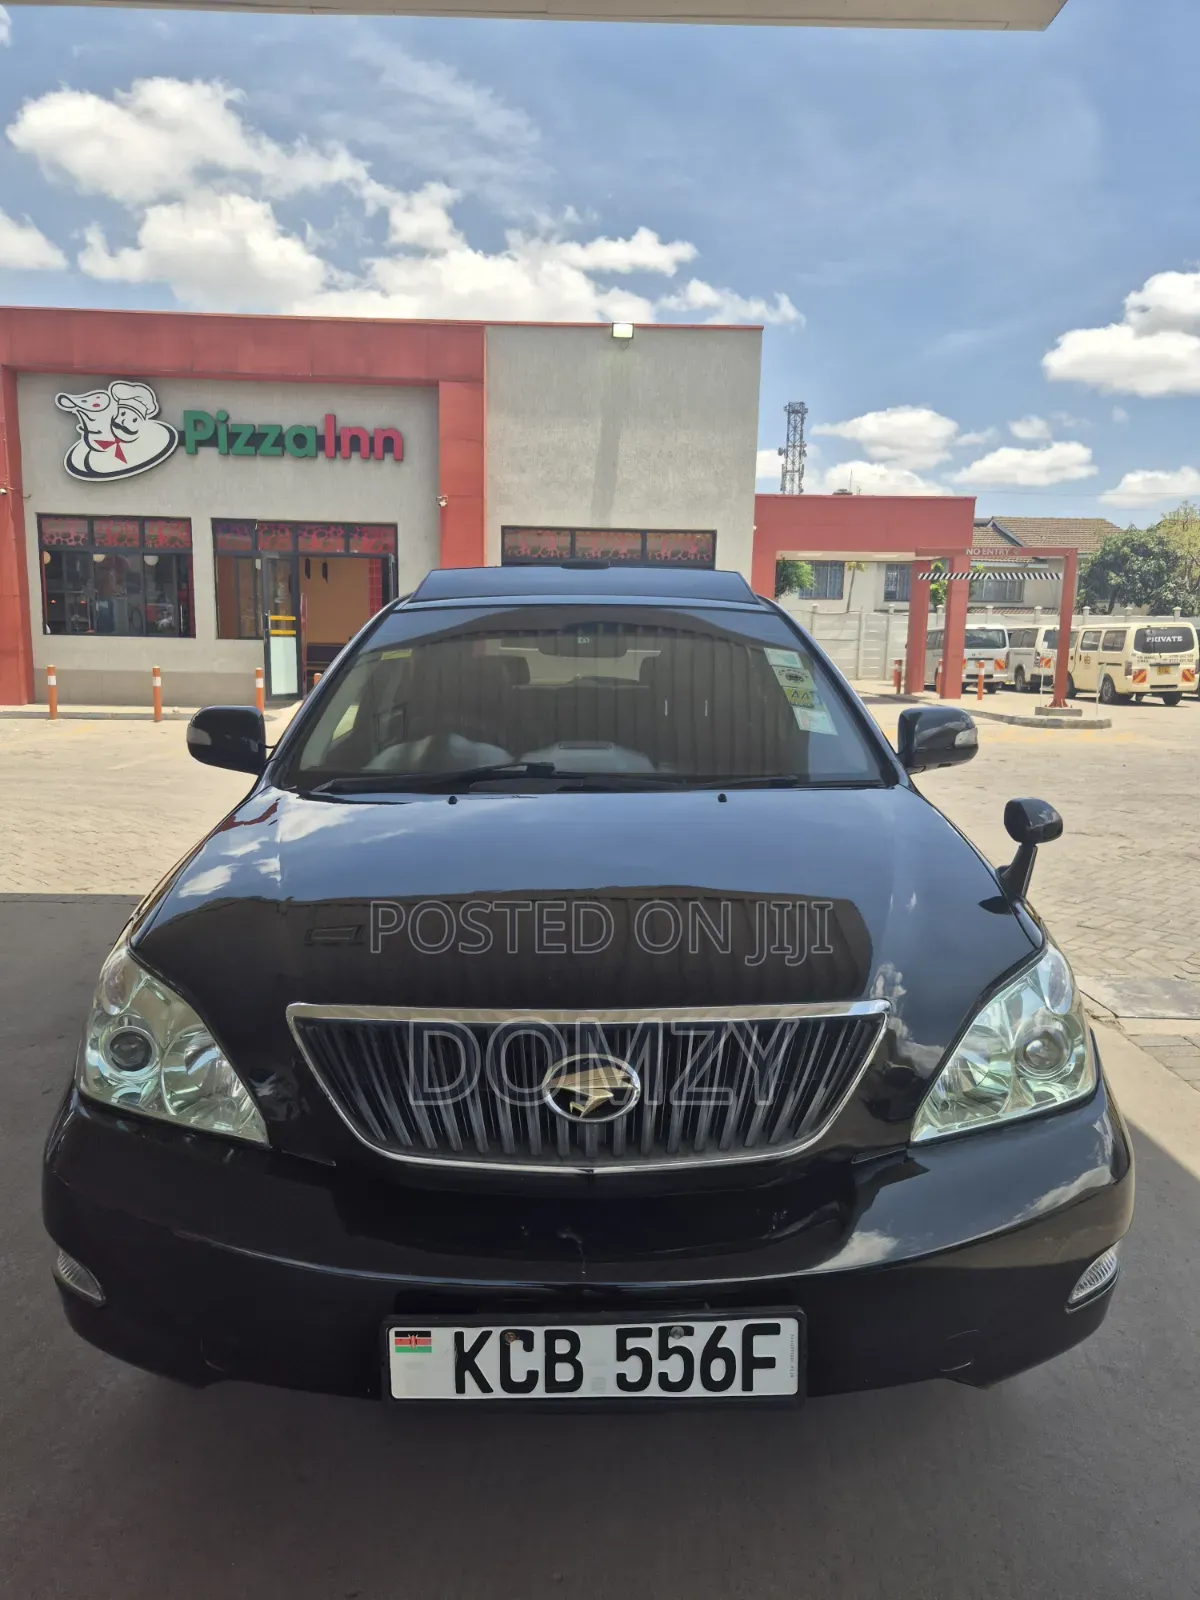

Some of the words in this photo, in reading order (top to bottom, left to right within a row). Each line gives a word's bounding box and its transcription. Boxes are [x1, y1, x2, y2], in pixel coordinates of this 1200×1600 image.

[966, 548, 981, 556] NO
[982, 548, 1010, 556] ENTRY
[454, 1329, 584, 1394] KCB
[615, 1323, 781, 1393] 556F
